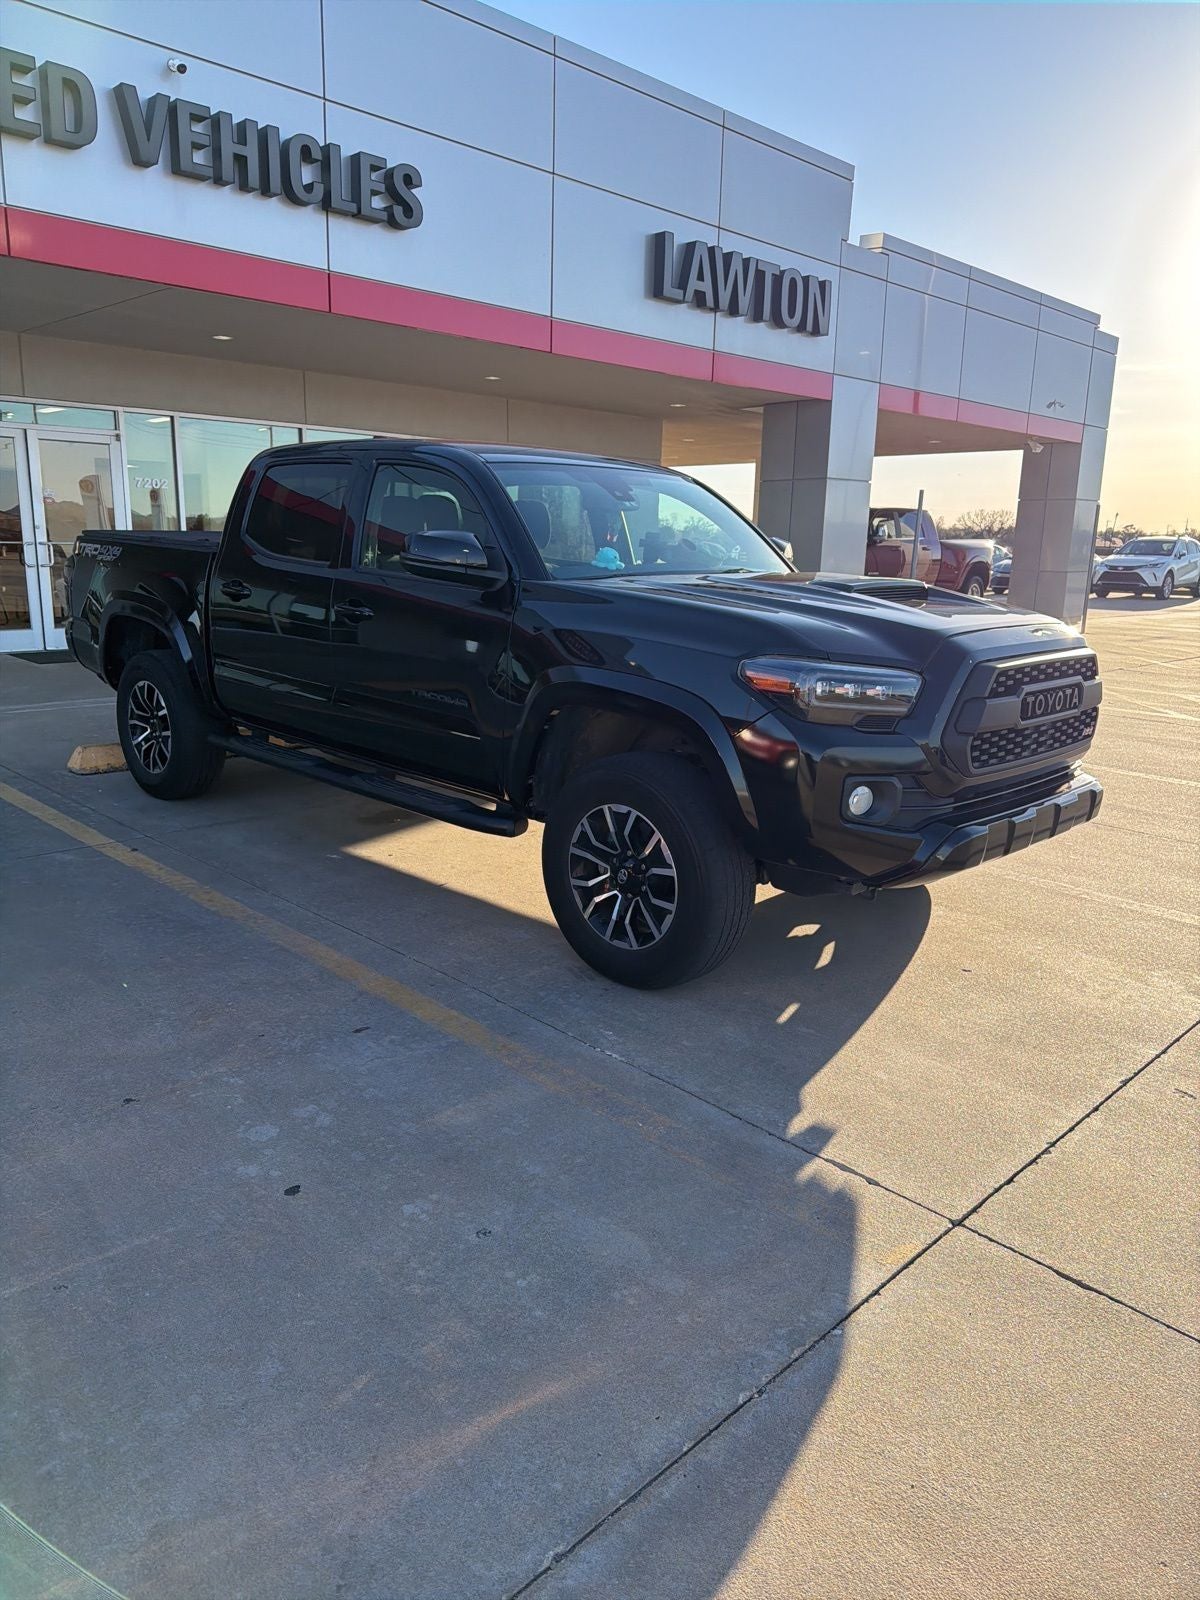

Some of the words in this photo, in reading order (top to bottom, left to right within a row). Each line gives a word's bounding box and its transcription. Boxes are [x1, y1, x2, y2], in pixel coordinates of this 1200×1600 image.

[0, 47, 98, 149] ED
[114, 82, 423, 230] VEHICLES
[652, 231, 832, 336] LAWTON
[134, 477, 169, 489] 7202
[1026, 687, 1079, 716] TOYOTA
